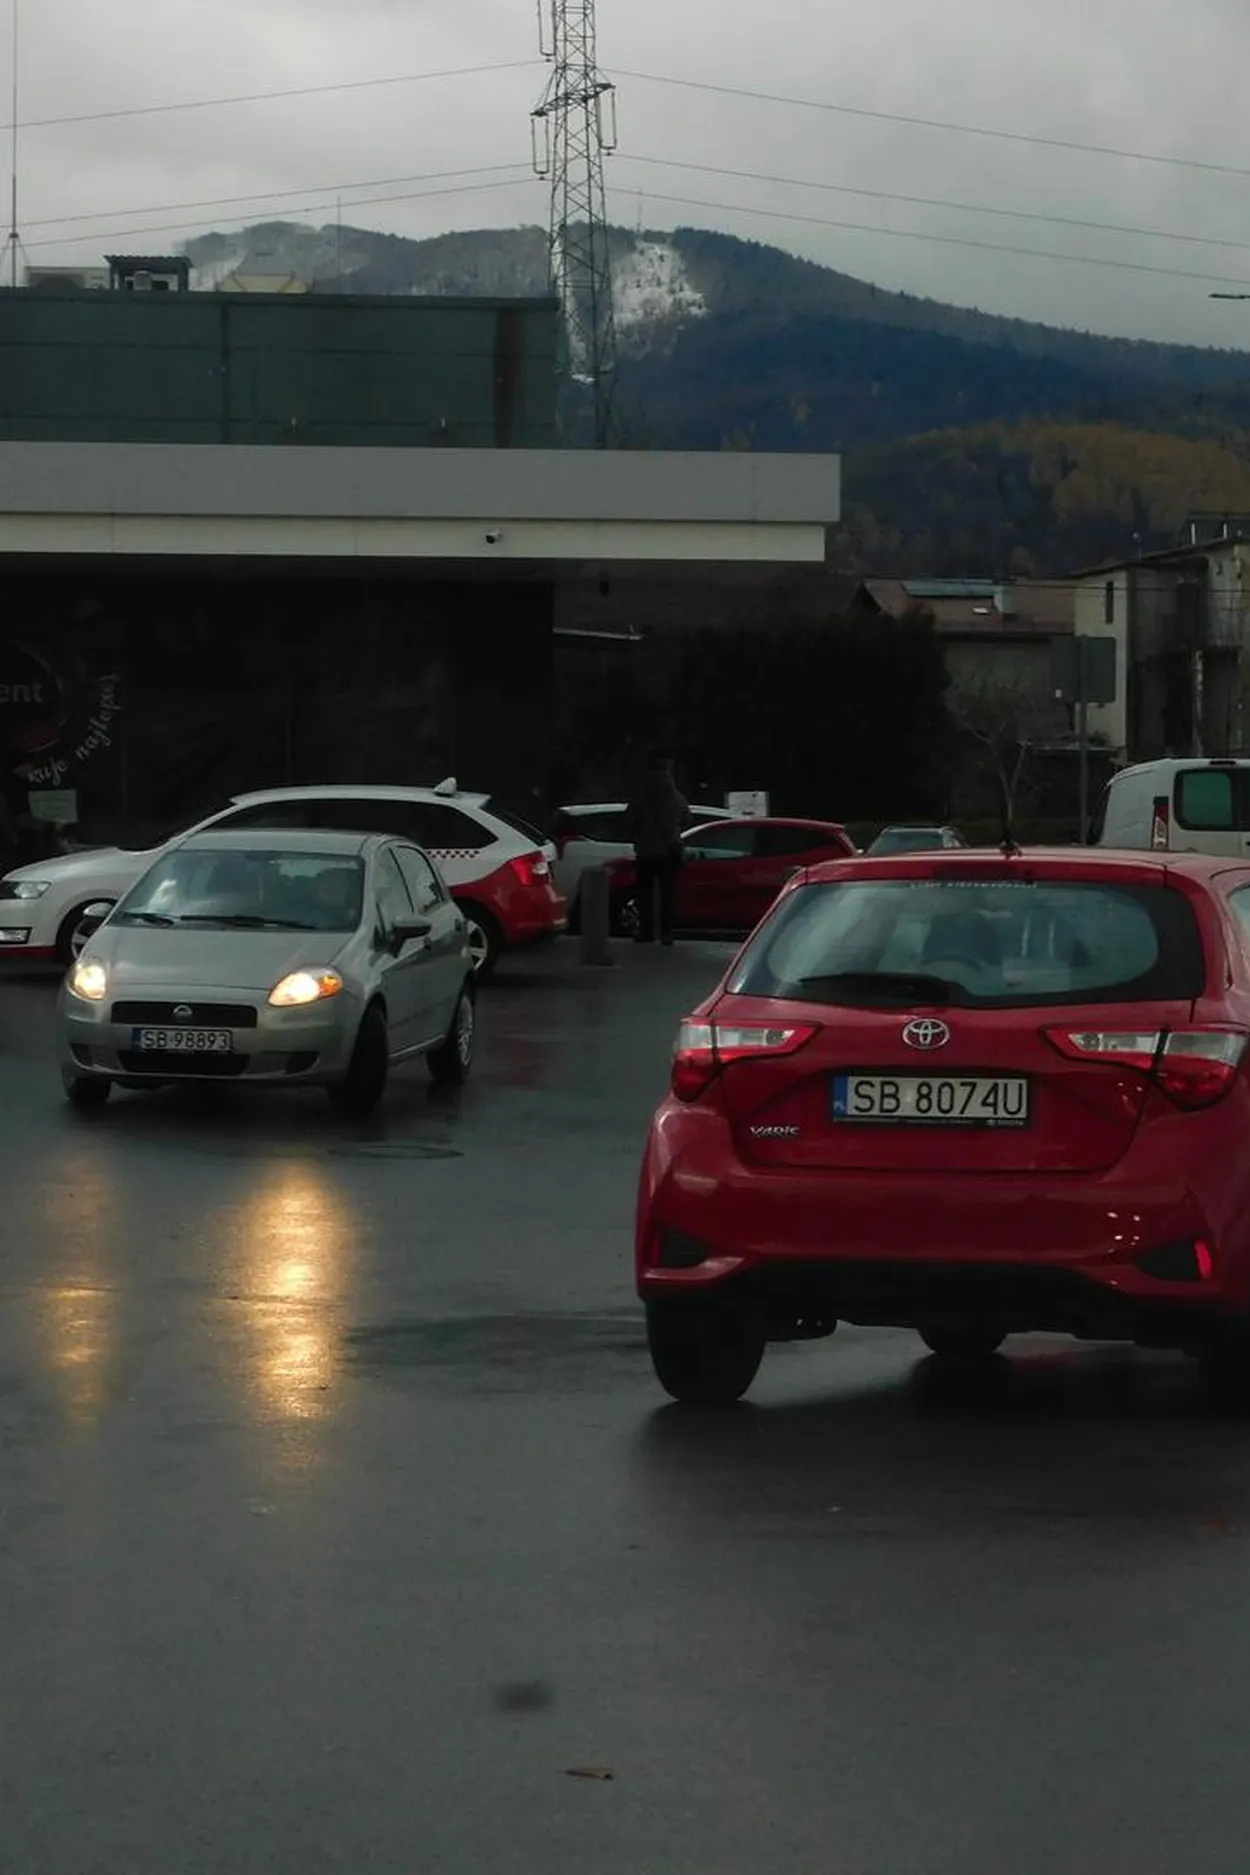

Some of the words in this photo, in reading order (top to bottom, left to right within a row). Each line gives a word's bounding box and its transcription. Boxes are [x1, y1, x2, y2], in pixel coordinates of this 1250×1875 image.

[0, 681, 43, 704] ent
[144, 1030, 168, 1048] SB
[174, 1032, 228, 1049] 98893
[854, 1080, 900, 1113] SB
[915, 1081, 1024, 1115] 8074U
